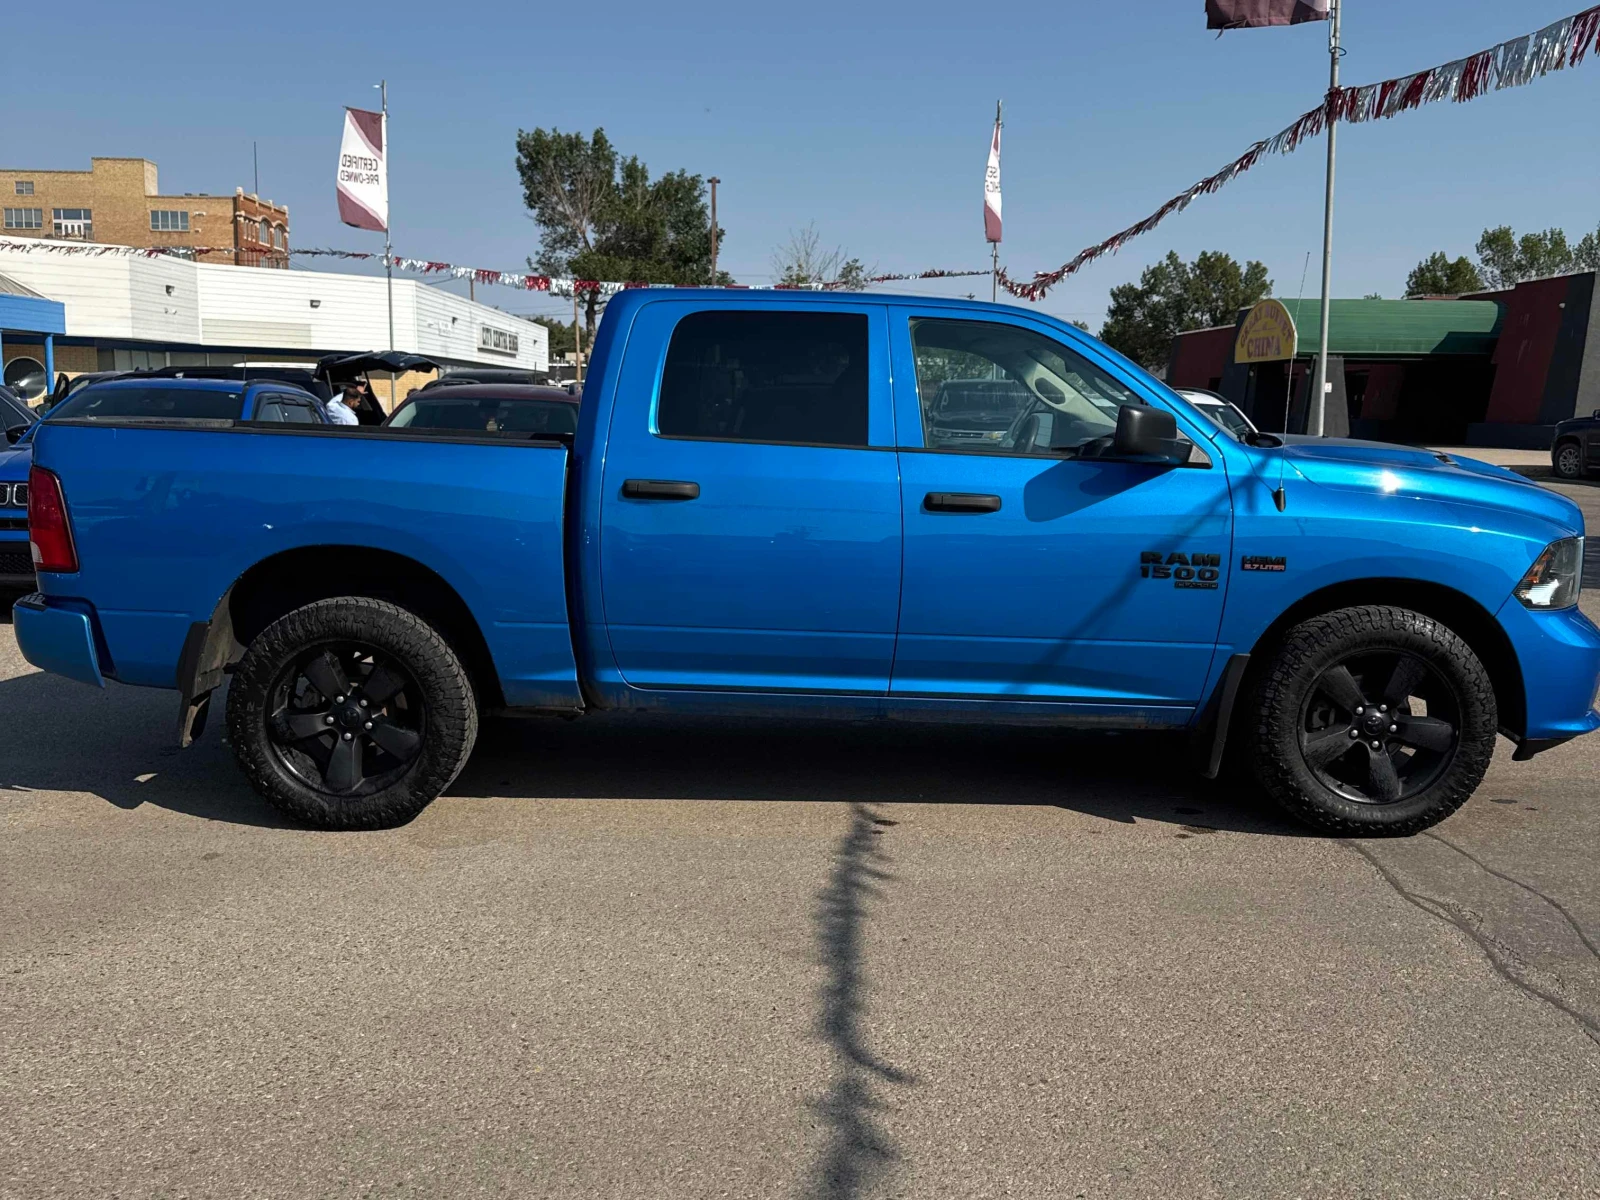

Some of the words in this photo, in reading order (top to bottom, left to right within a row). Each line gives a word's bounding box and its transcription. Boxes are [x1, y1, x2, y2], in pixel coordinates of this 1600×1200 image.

[1247, 336, 1281, 358] CHINA
[1141, 552, 1220, 566] RAM
[1242, 555, 1287, 565] HEMI
[1140, 565, 1219, 580] 1500
